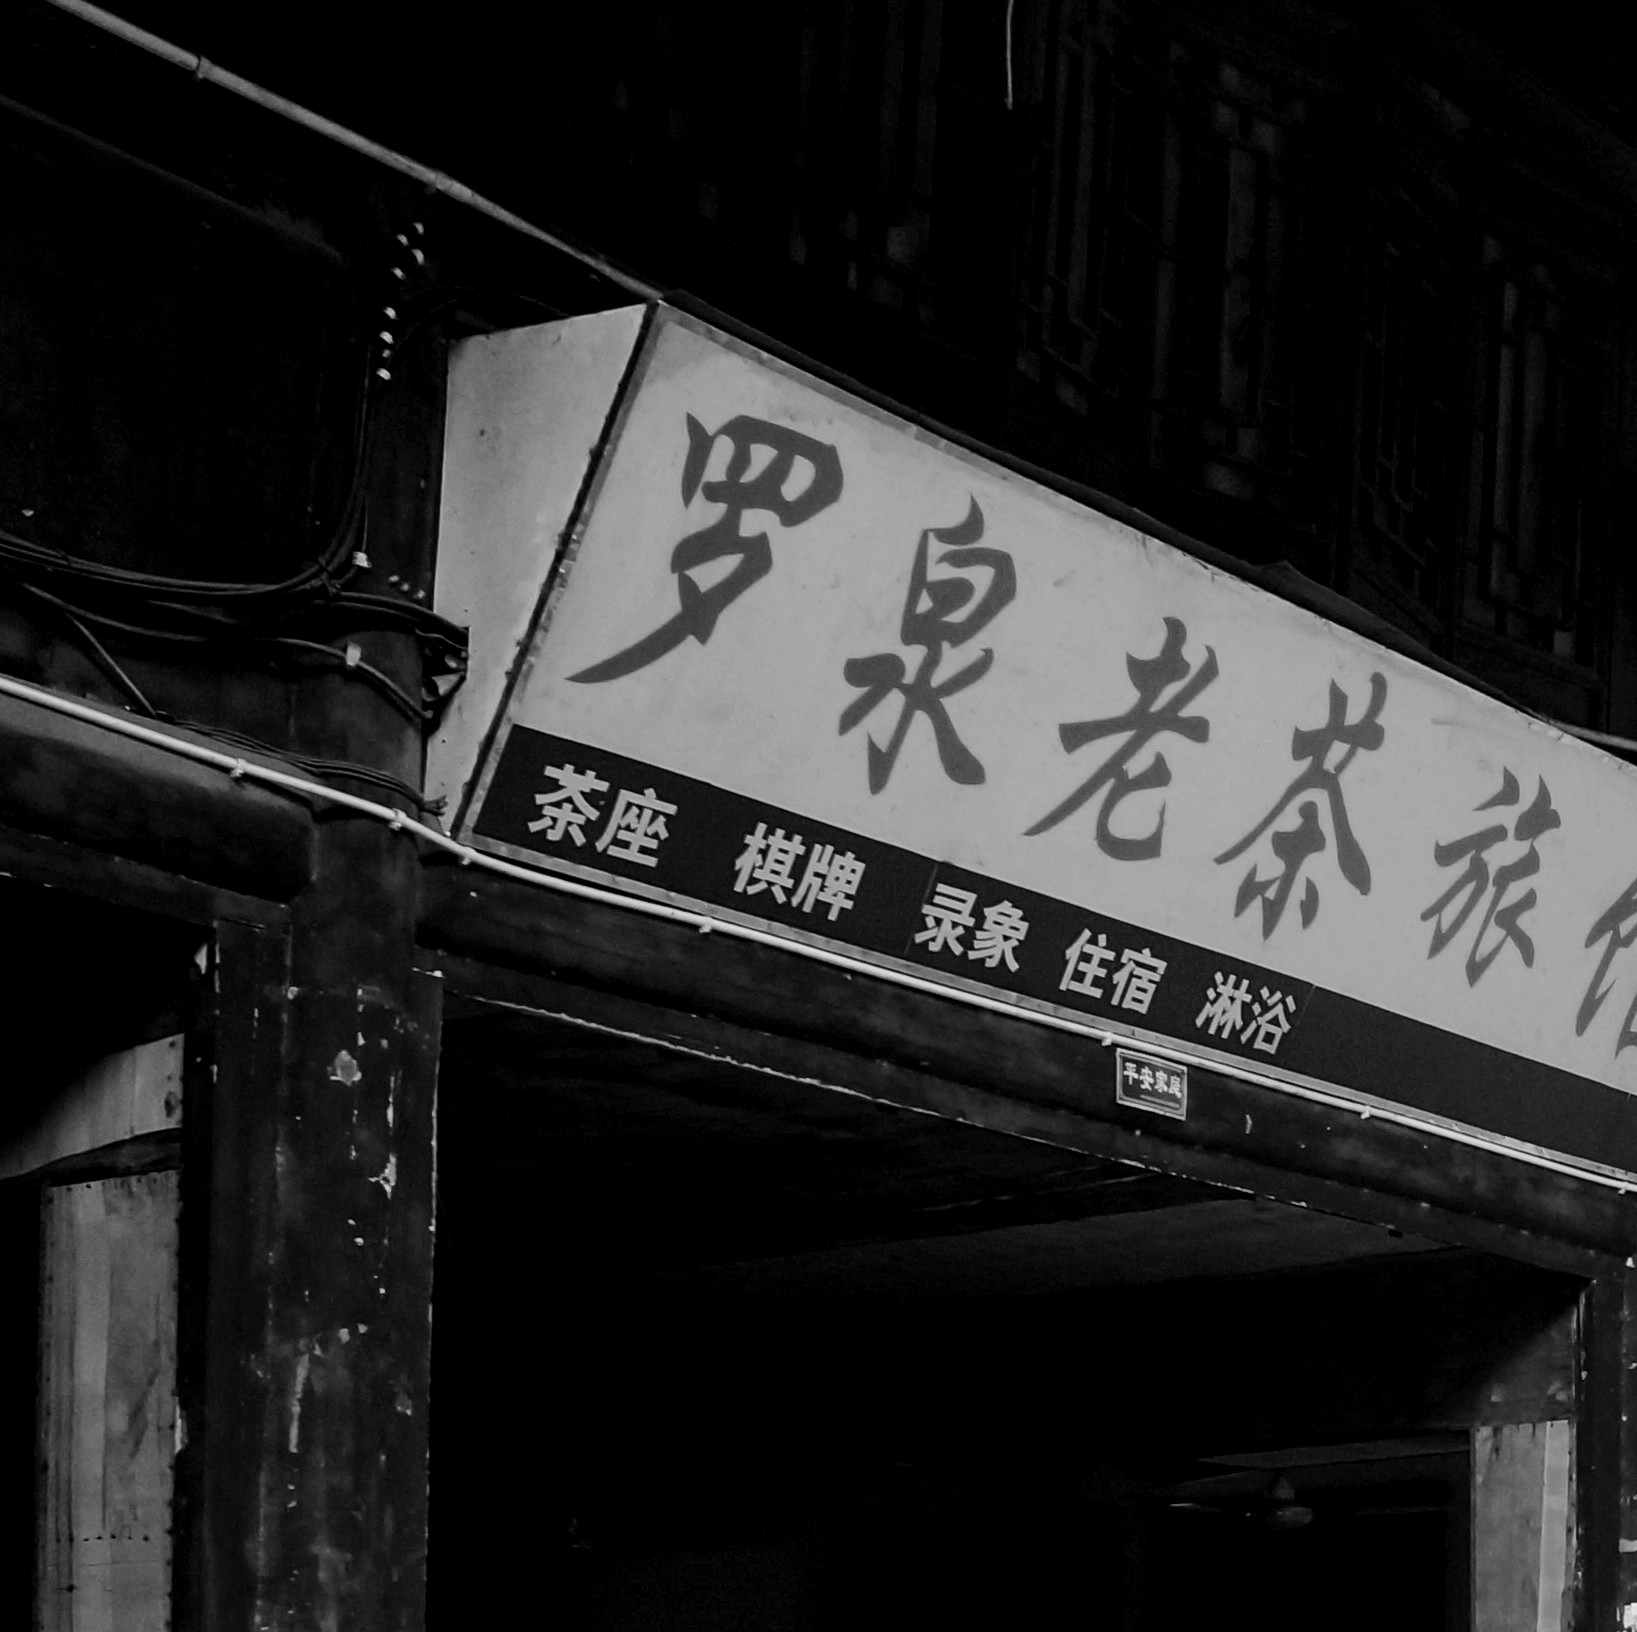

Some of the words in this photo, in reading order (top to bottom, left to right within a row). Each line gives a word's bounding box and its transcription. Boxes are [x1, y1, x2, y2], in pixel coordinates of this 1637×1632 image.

[528, 763, 678, 868] 茶座
[733, 822, 866, 922] 棋牌
[914, 882, 1030, 973] 录象
[1059, 928, 1168, 1015] 住宿
[1195, 971, 1297, 1055] 淋浴
